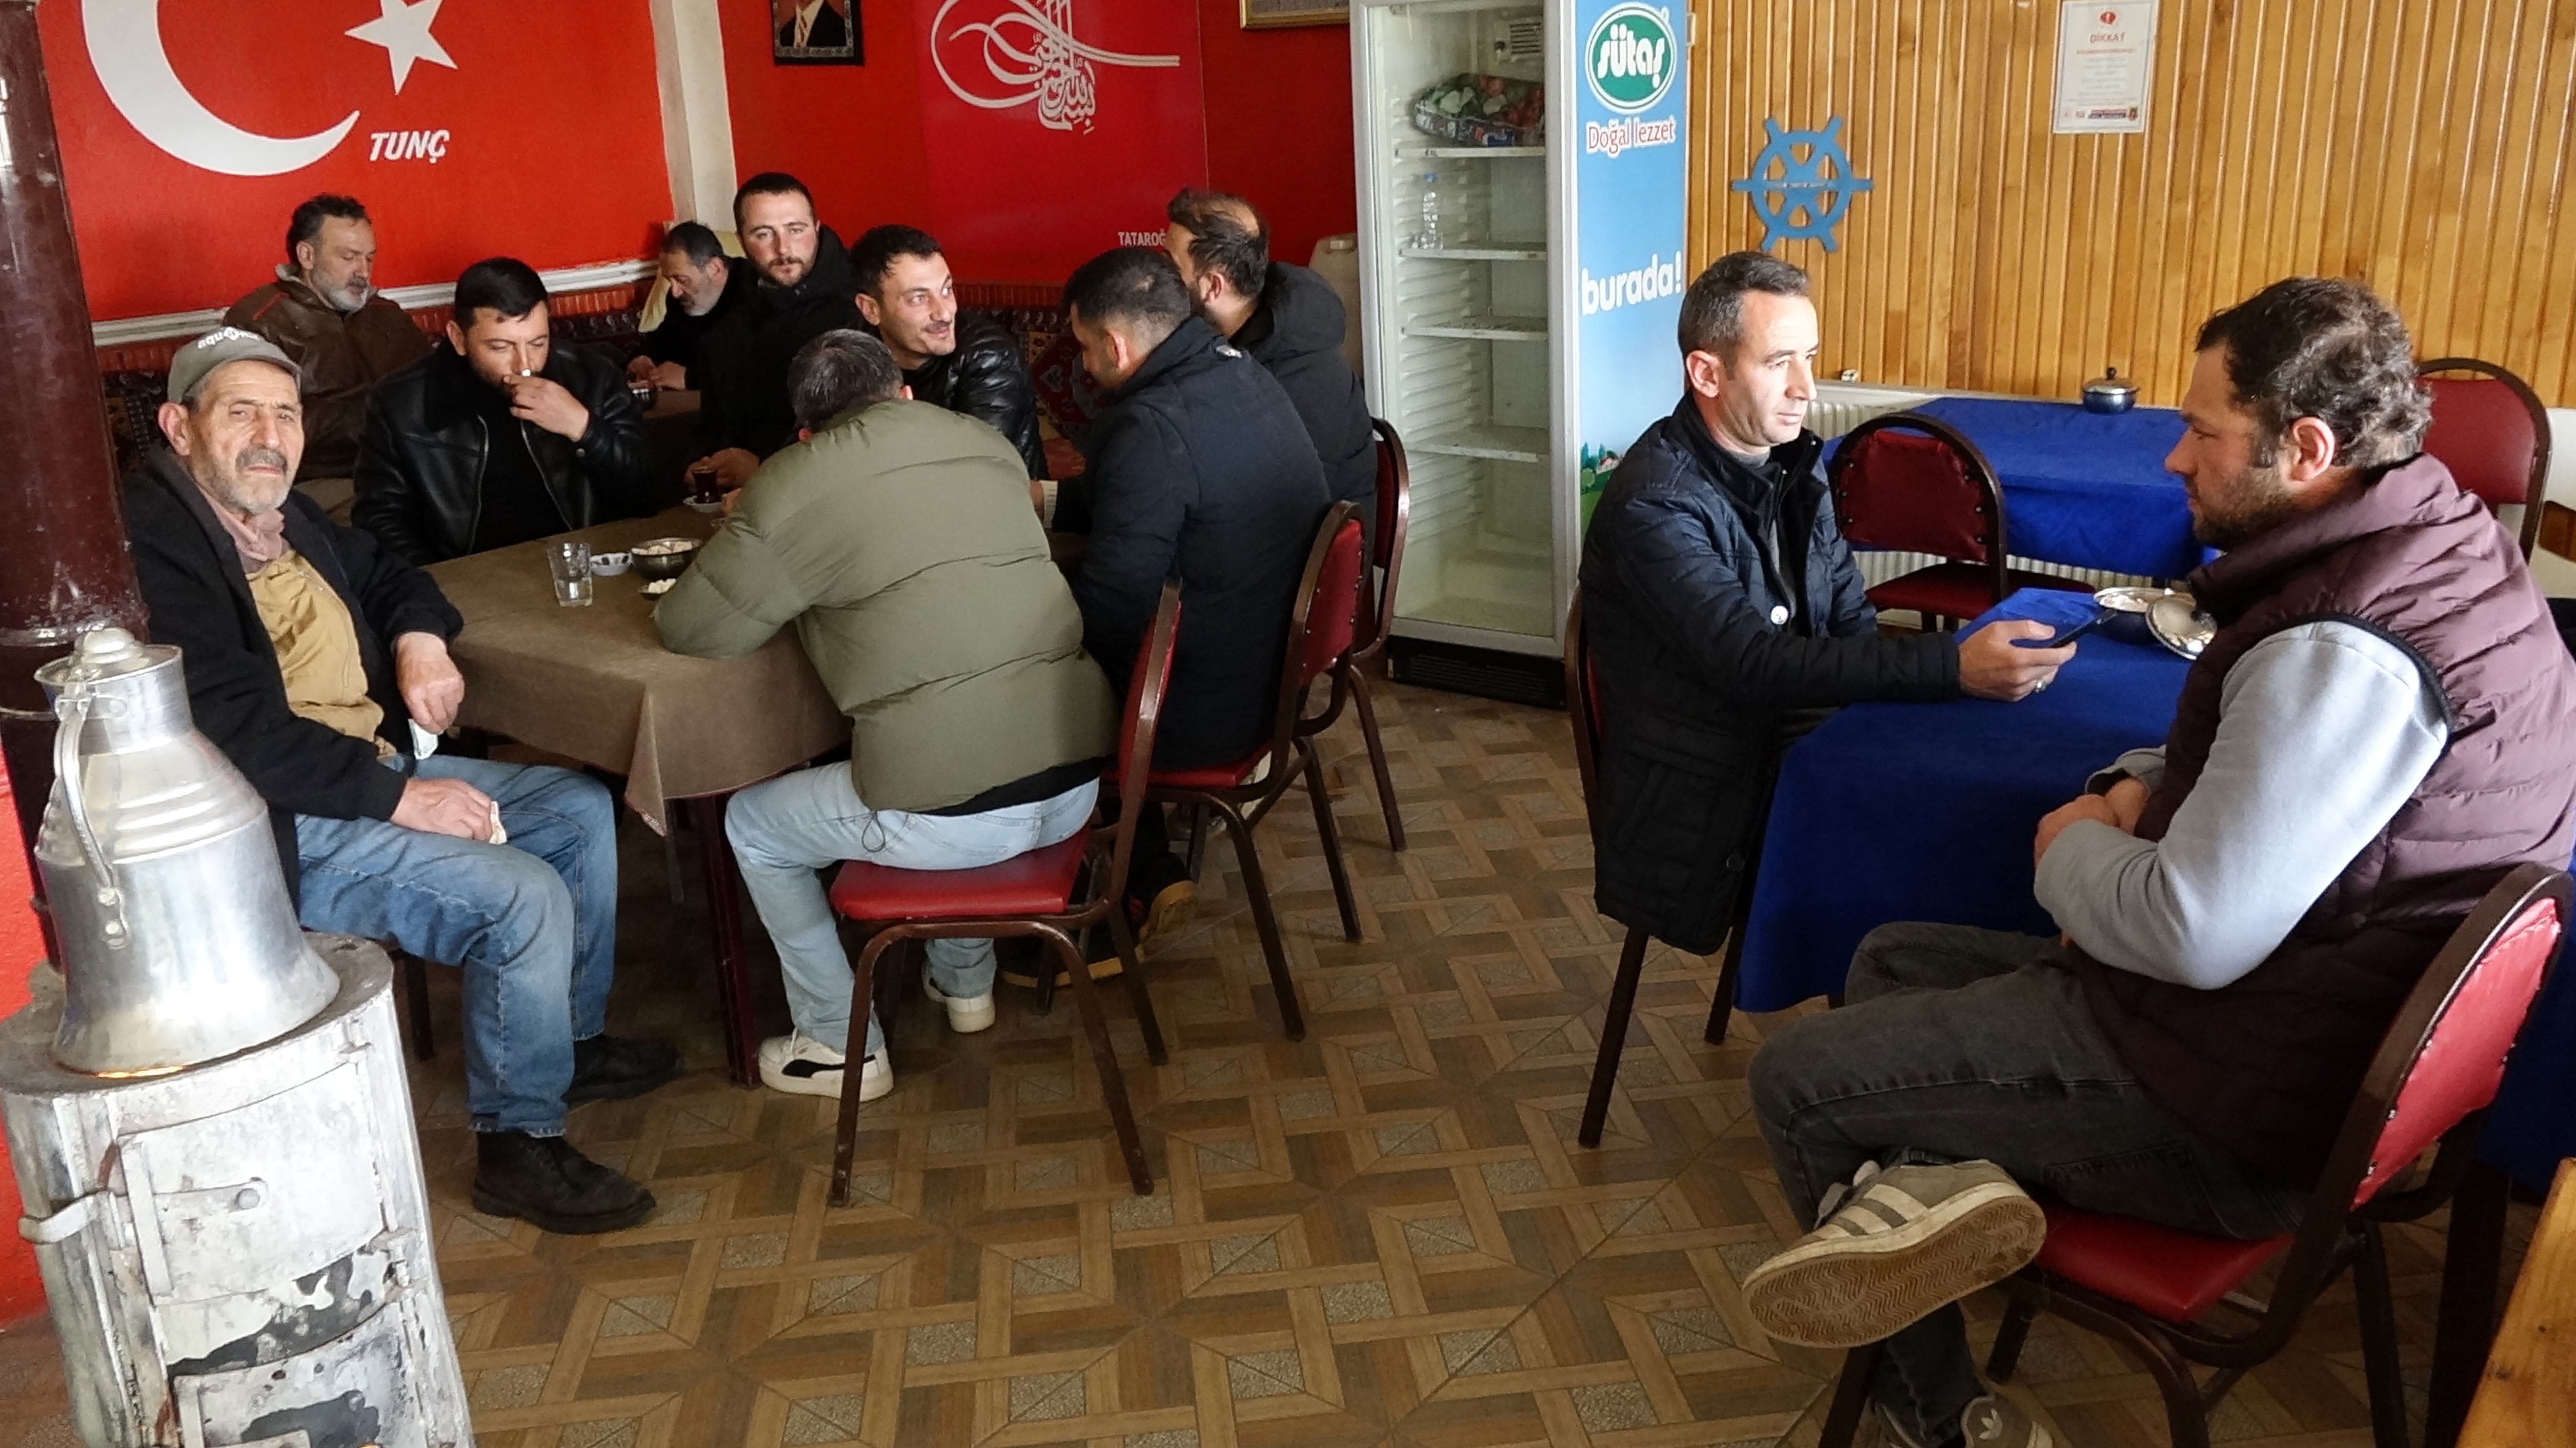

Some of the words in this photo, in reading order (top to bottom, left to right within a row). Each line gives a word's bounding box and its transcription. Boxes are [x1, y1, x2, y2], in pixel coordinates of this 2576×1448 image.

[370, 130, 450, 164] TUNÇ
[1588, 121, 1629, 154] Doğal
[1635, 120, 1674, 144] lezzet
[1118, 228, 1165, 246] TATAROĞ
[1581, 251, 1681, 316] burada!
